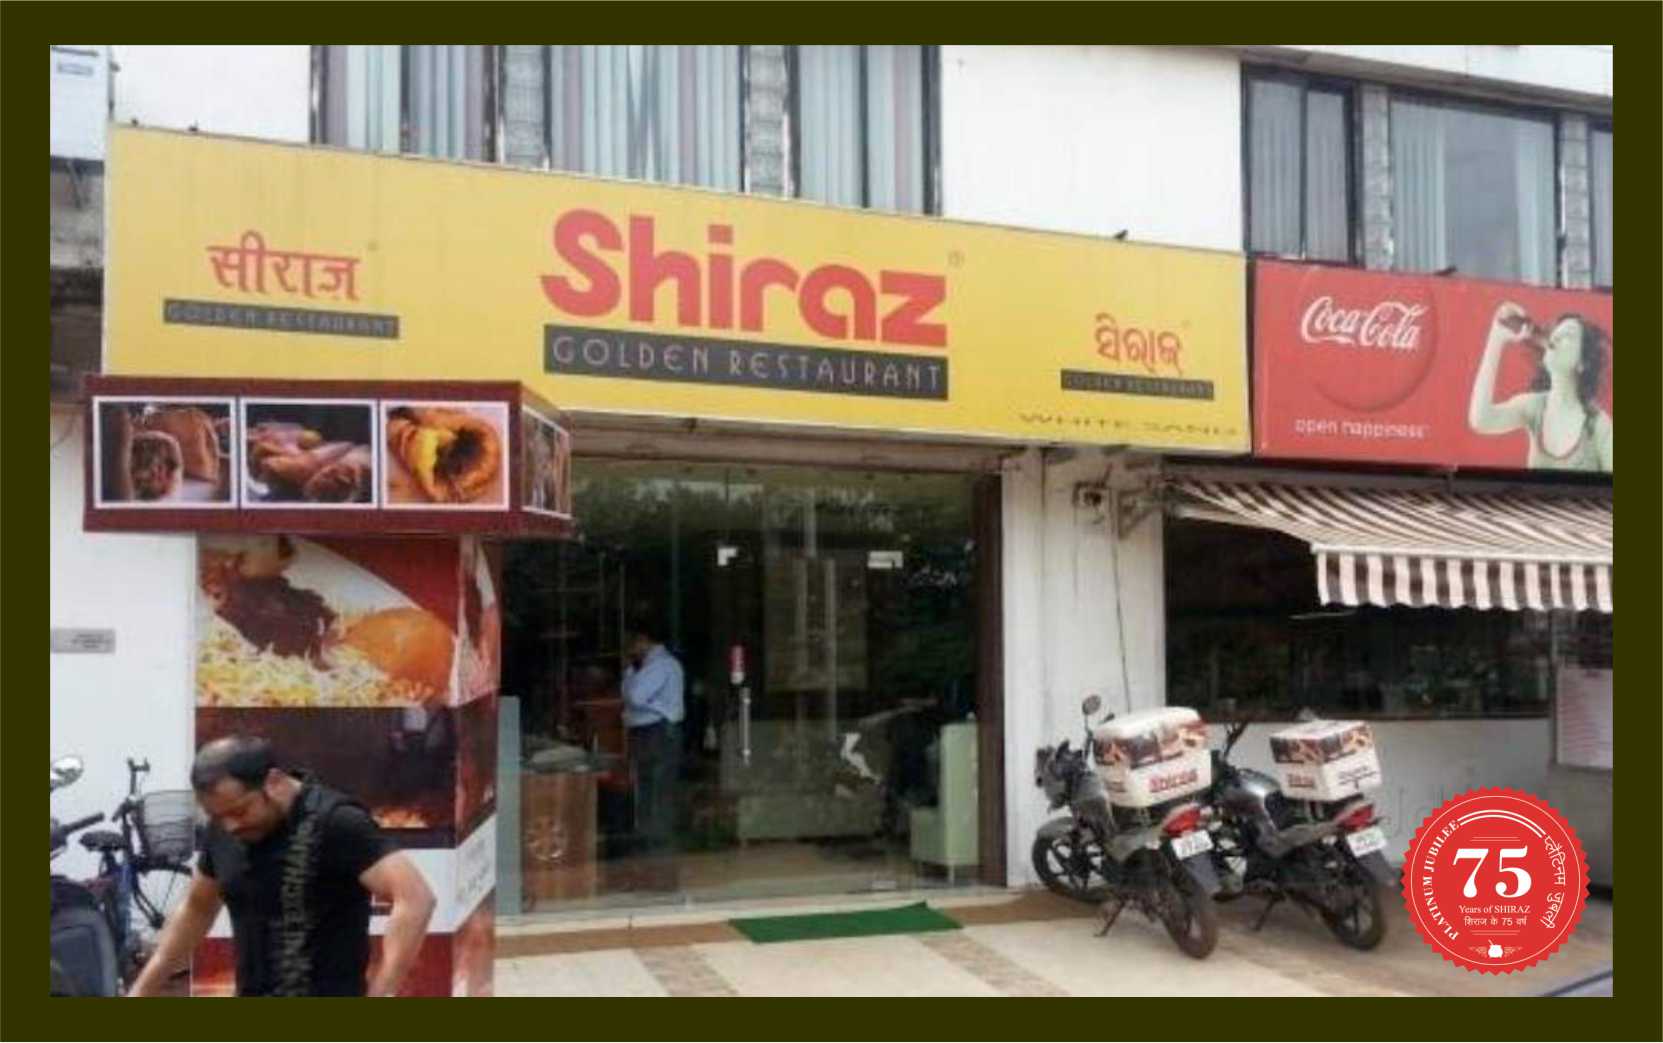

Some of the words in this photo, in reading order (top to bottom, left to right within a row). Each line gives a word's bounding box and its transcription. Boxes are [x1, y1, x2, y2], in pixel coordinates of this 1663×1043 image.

[541, 208, 948, 347] Shiraz
[552, 336, 710, 376] GOLDEN
[729, 349, 942, 391] RESTAURANT
[1294, 416, 1338, 437] open
